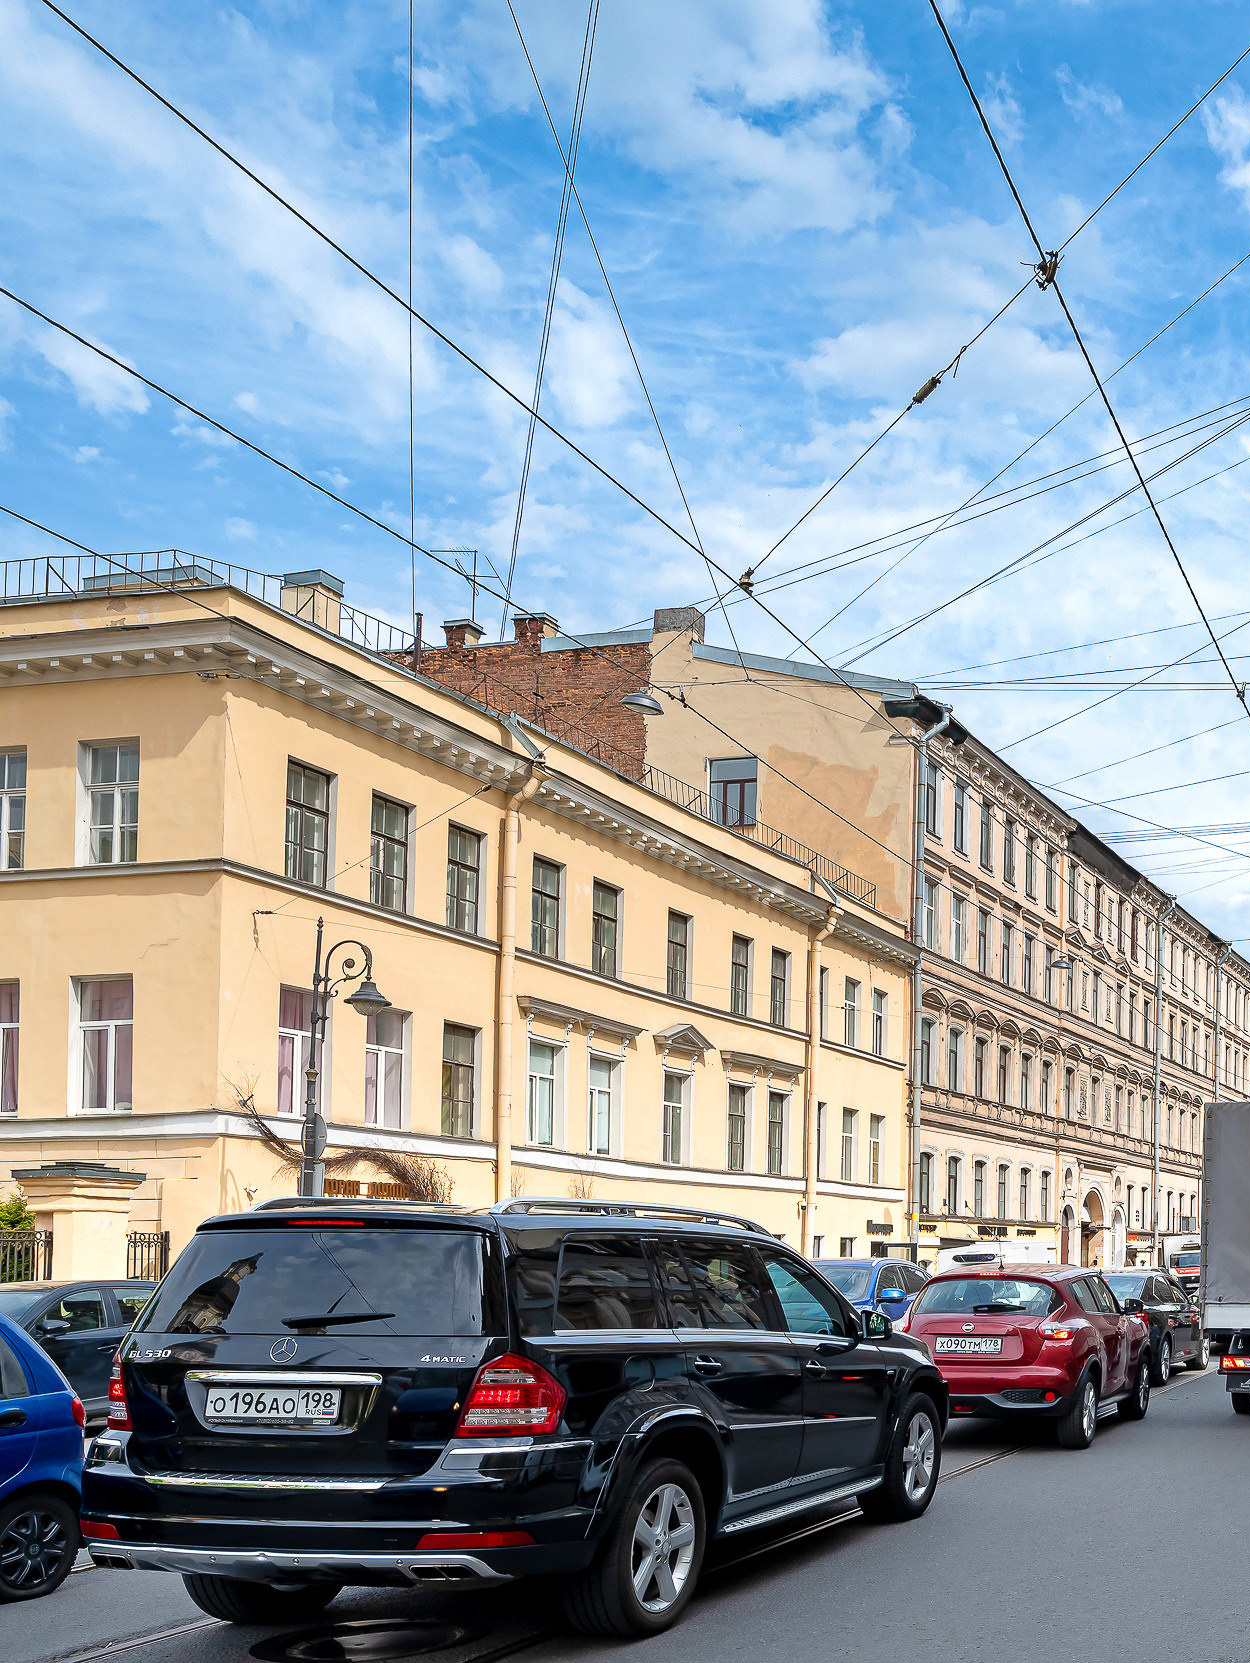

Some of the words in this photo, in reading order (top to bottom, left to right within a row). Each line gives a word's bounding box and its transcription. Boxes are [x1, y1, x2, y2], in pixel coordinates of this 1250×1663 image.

[939, 1339, 981, 1349] Х090ТМ
[983, 1339, 999, 1347] 178
[213, 1391, 296, 1414] О196АО
[300, 1391, 334, 1409] 198
